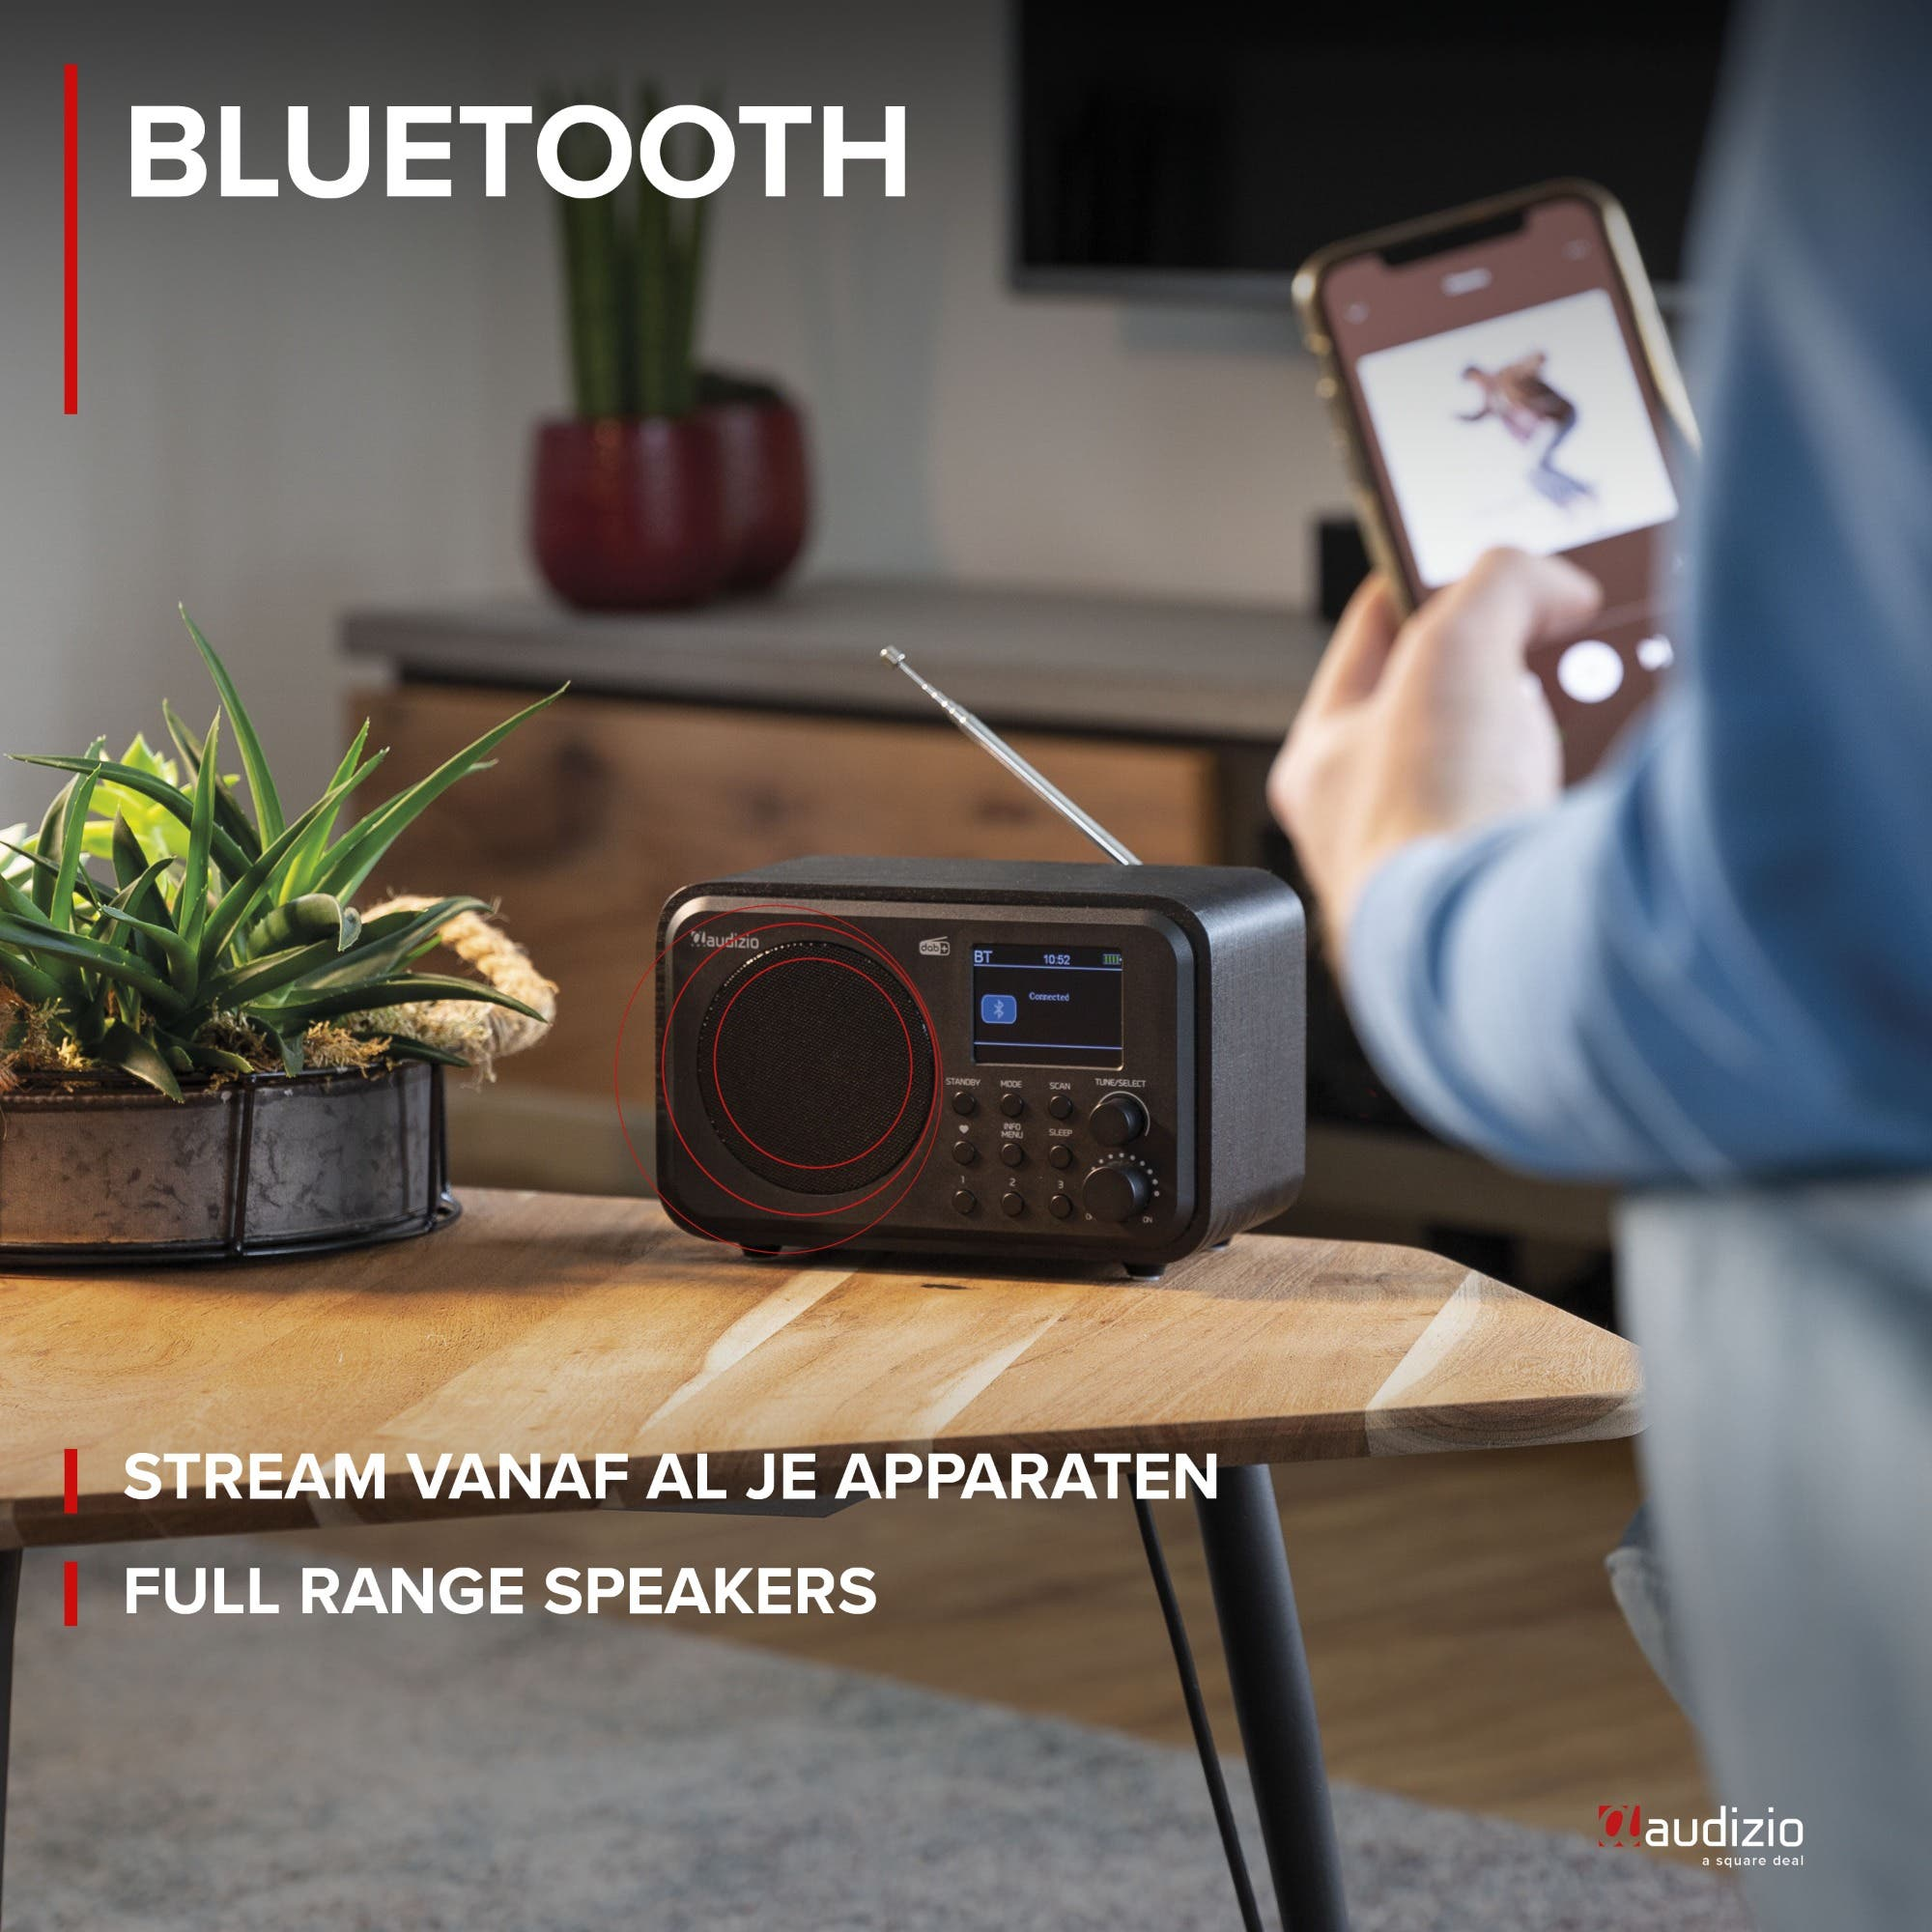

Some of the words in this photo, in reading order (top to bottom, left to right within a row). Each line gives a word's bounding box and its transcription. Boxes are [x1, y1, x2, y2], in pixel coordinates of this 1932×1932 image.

[974, 950, 993, 963] BT
[1043, 954, 1070, 965] 10:52
[1029, 991, 1069, 1002] Connected
[946, 1078, 981, 1087] STANDBY
[1000, 1080, 1022, 1089] MODE
[1049, 1082, 1071, 1091] SCAN
[1094, 1078, 1147, 1088] TUNE/SELECT
[1004, 1122, 1021, 1131] INFO
[1002, 1130, 1024, 1139] MENU
[1049, 1128, 1072, 1137] SLEEP
[960, 1176, 966, 1184] 1
[1009, 1178, 1016, 1186] 2
[1058, 1180, 1065, 1189] 3
